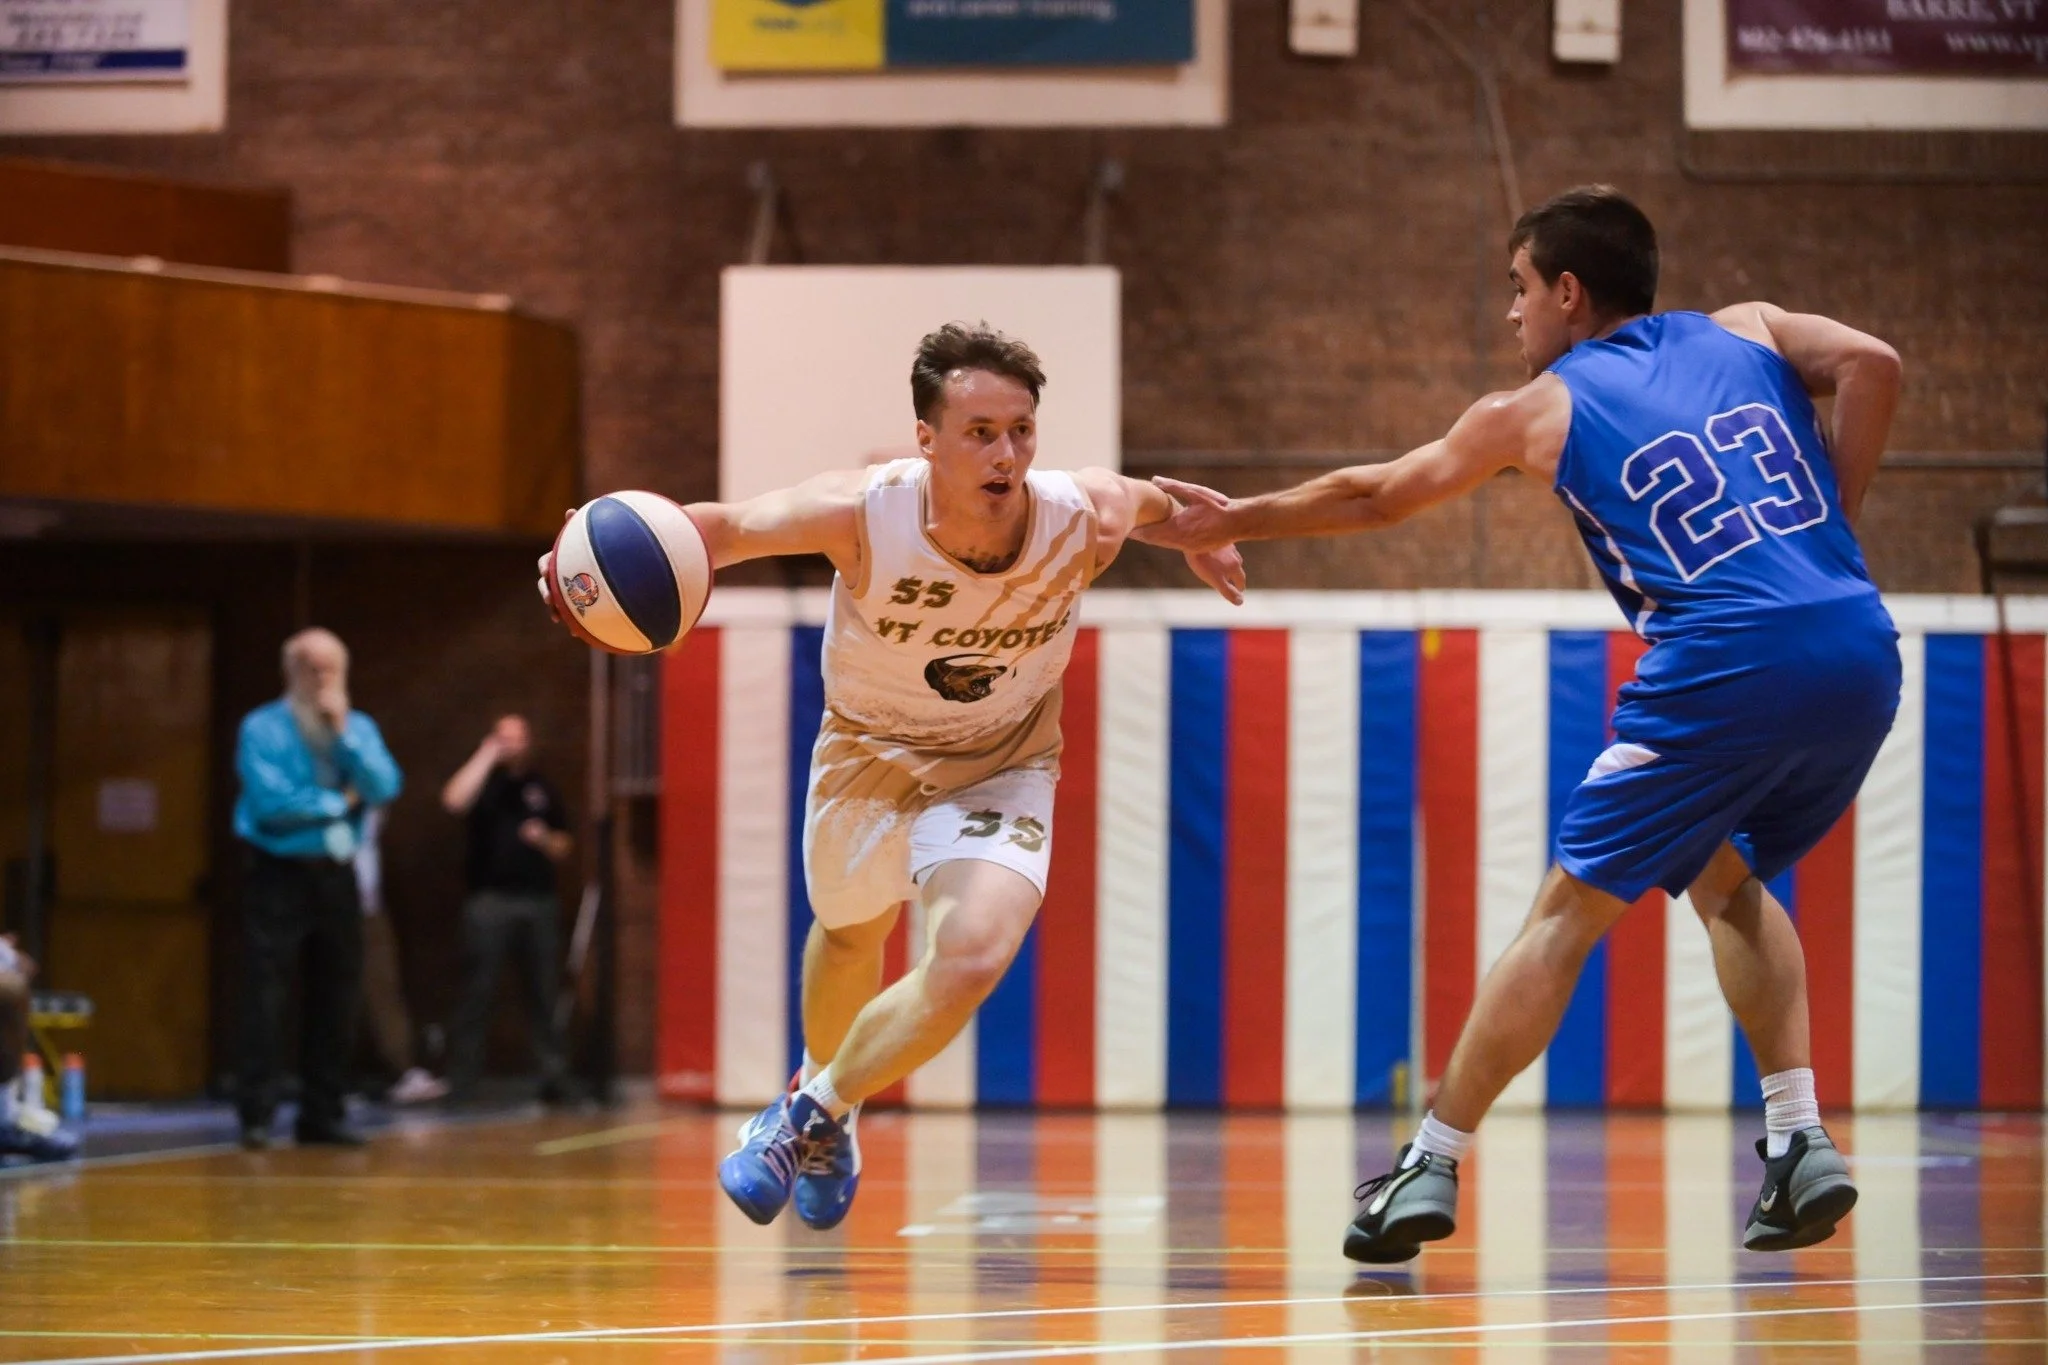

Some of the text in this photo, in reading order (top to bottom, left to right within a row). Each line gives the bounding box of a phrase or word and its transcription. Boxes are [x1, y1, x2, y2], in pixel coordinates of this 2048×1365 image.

[1621, 403, 1829, 584] 23
[887, 577, 959, 609] 55
[875, 617, 923, 645] VT
